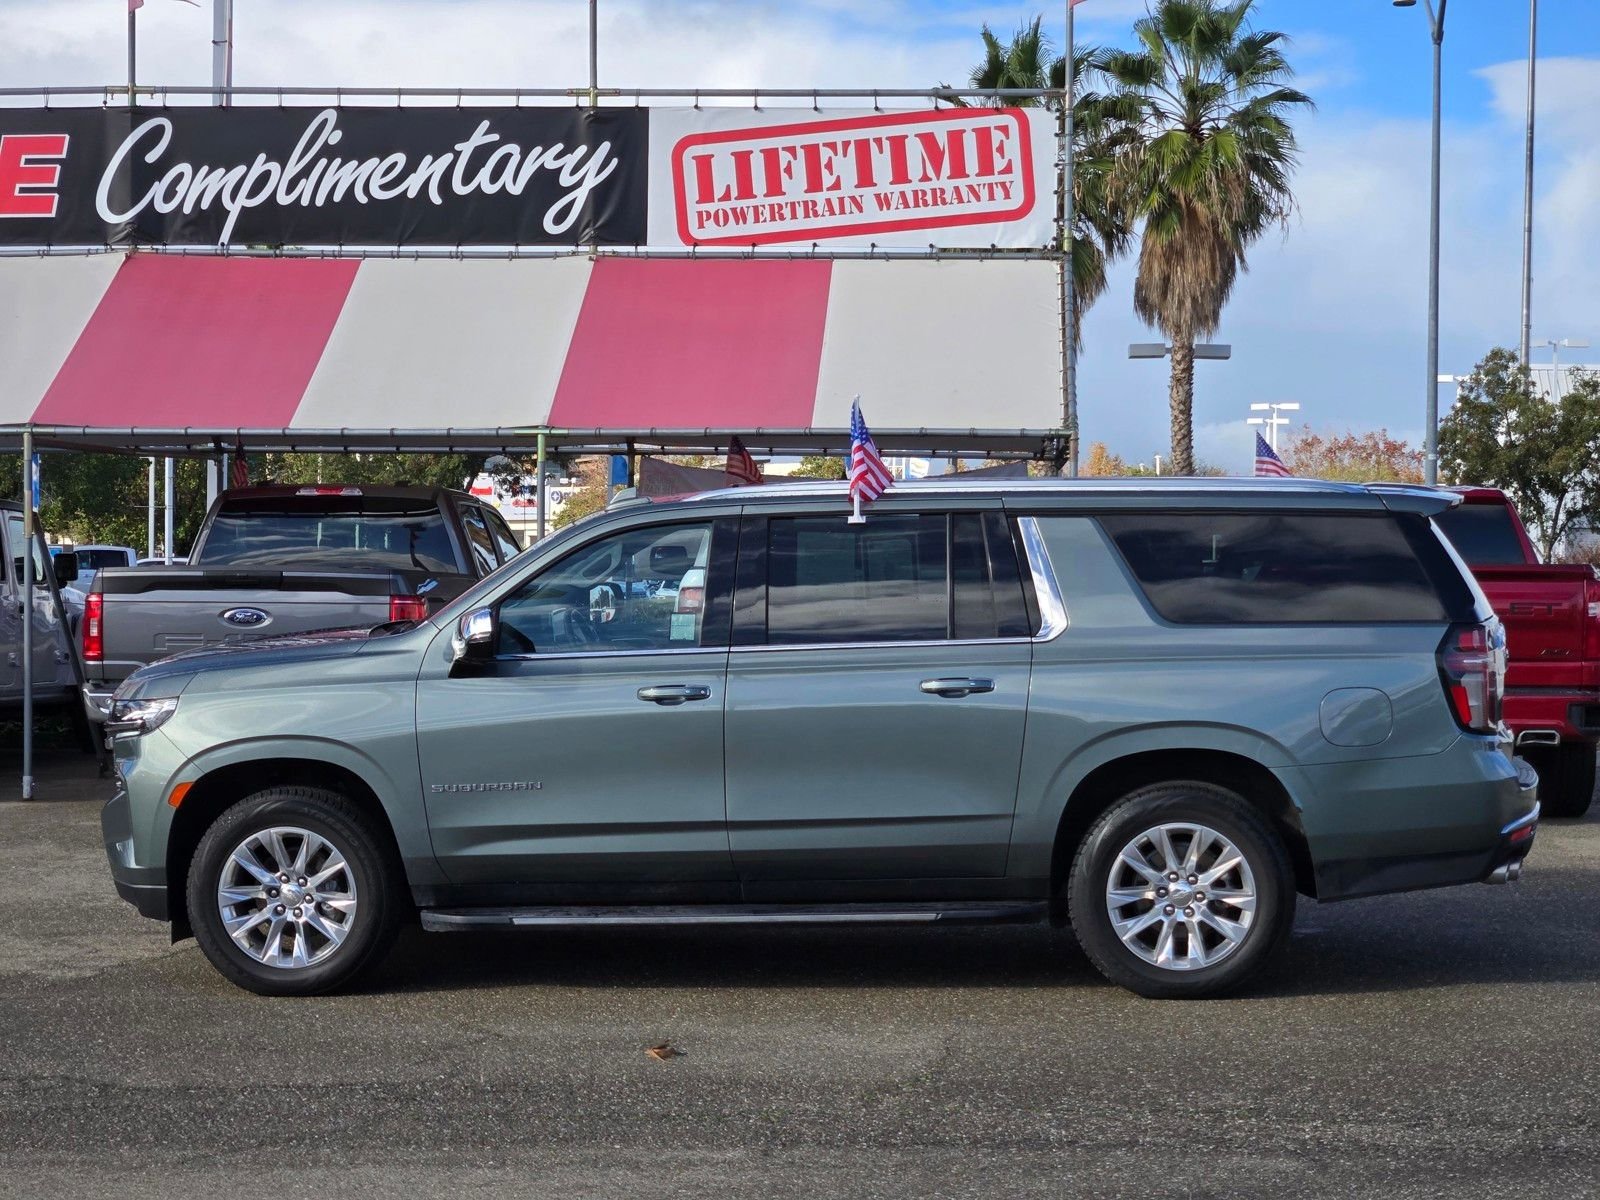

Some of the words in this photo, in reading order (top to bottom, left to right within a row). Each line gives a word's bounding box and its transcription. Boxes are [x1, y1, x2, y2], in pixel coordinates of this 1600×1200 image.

[94, 108, 618, 245] Complimentary
[691, 124, 1014, 205] LIFETIME
[695, 194, 864, 230] POWERTRAIN
[872, 180, 1014, 212] WARRANTY
[431, 781, 543, 793] SUBURBAN
